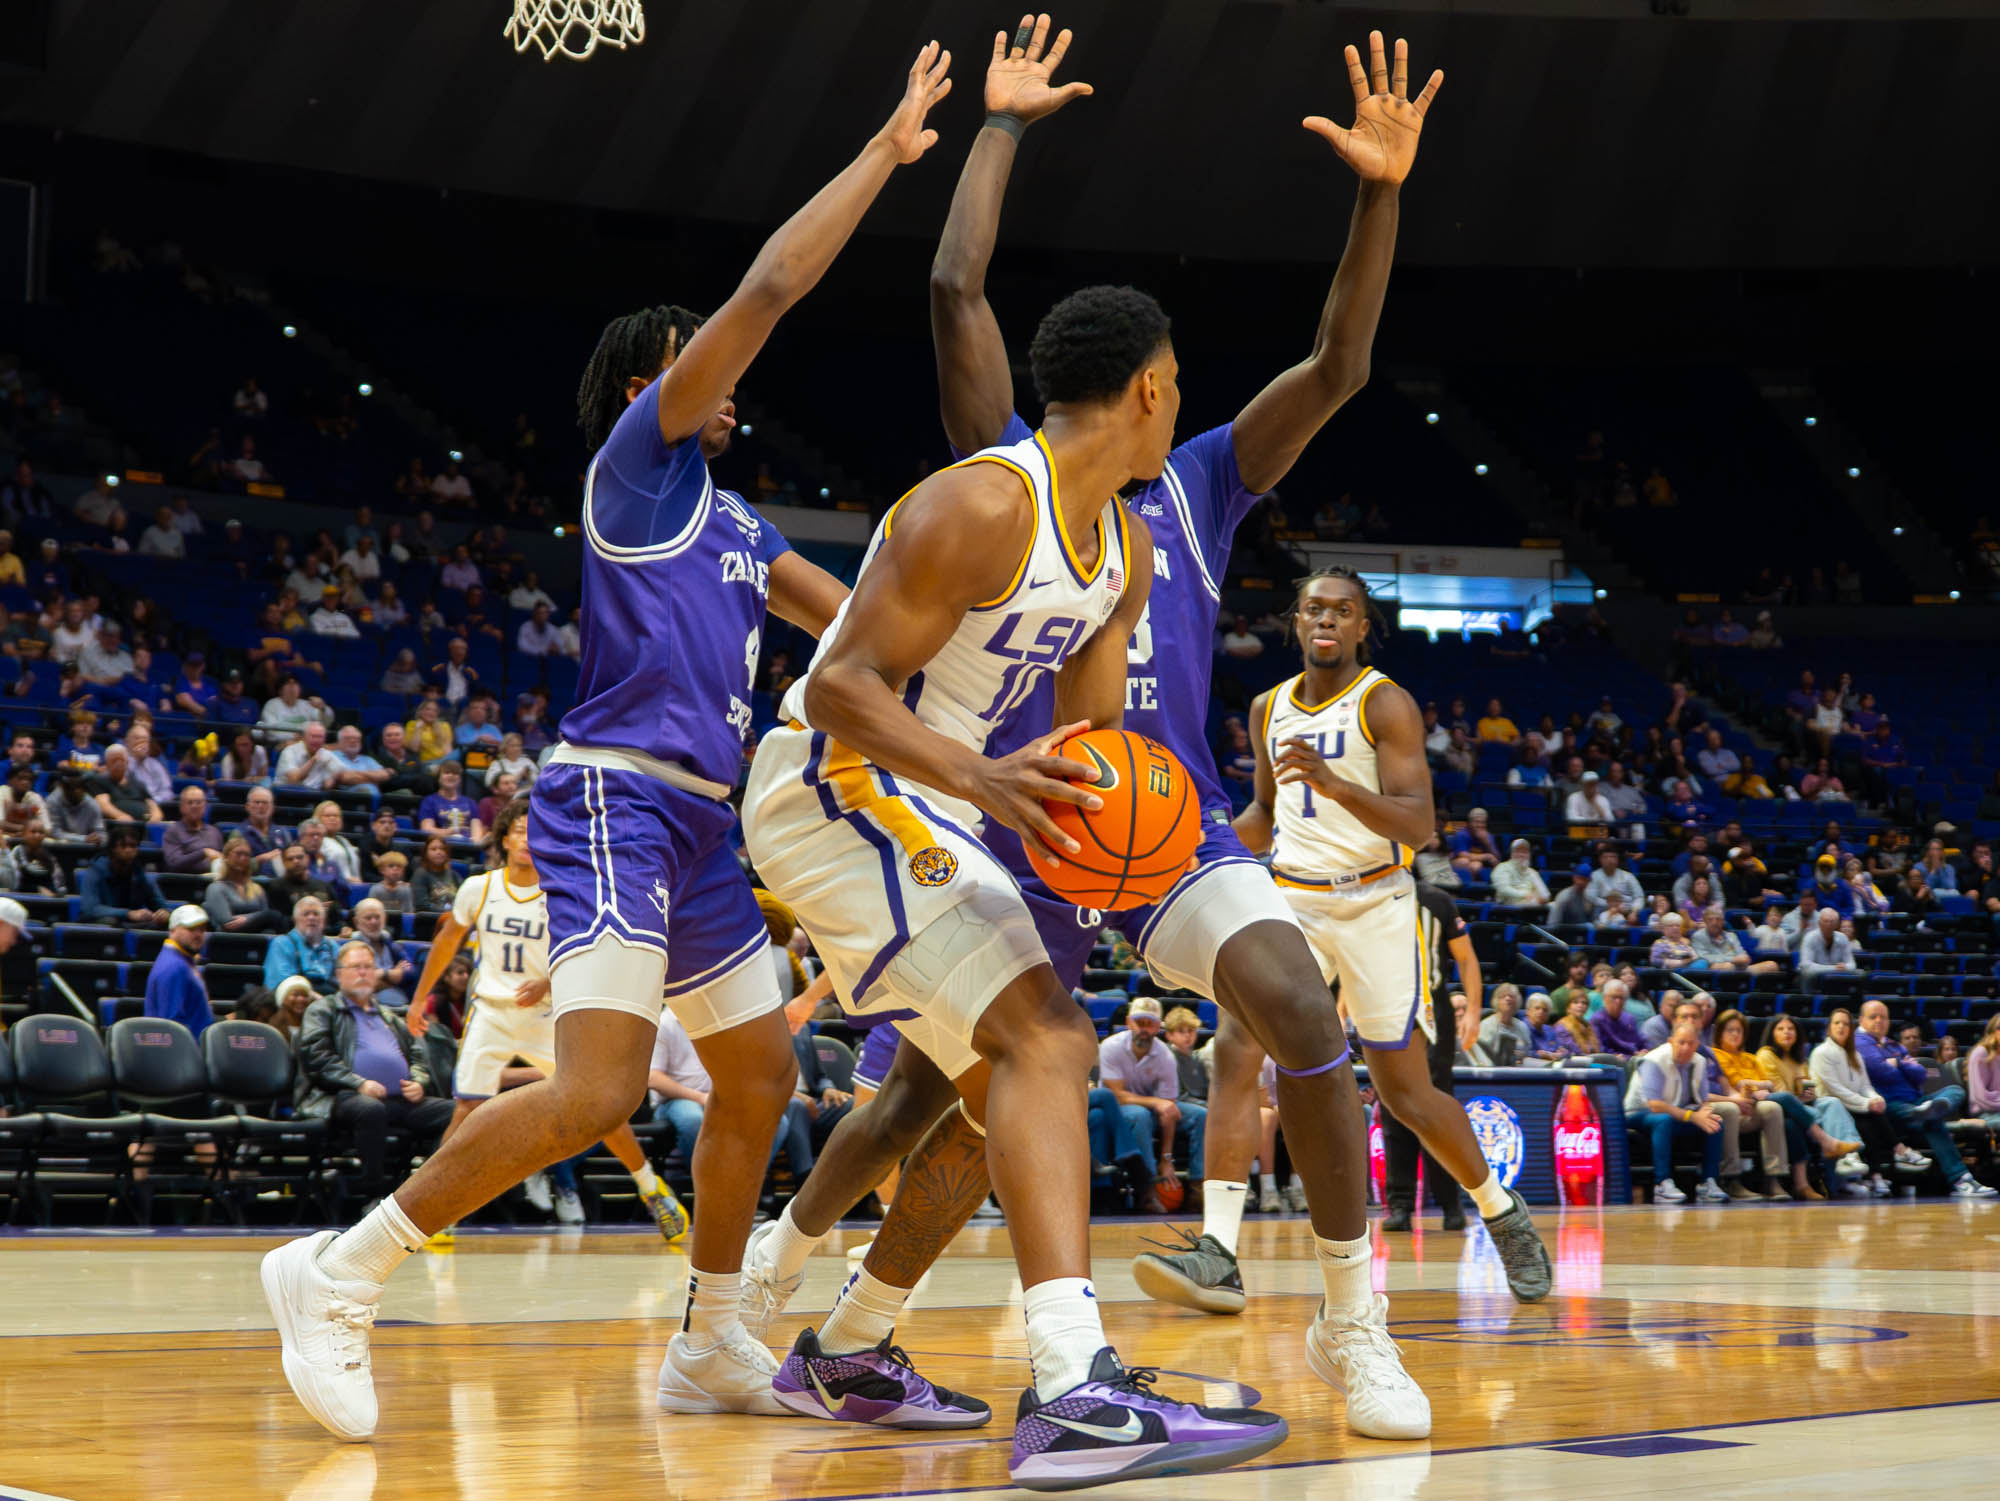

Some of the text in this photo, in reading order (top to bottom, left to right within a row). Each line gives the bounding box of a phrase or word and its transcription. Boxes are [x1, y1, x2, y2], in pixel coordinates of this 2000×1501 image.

[1334, 874, 1356, 884] LSU
[485, 913, 545, 940] LSU
[502, 943, 525, 973] 11
